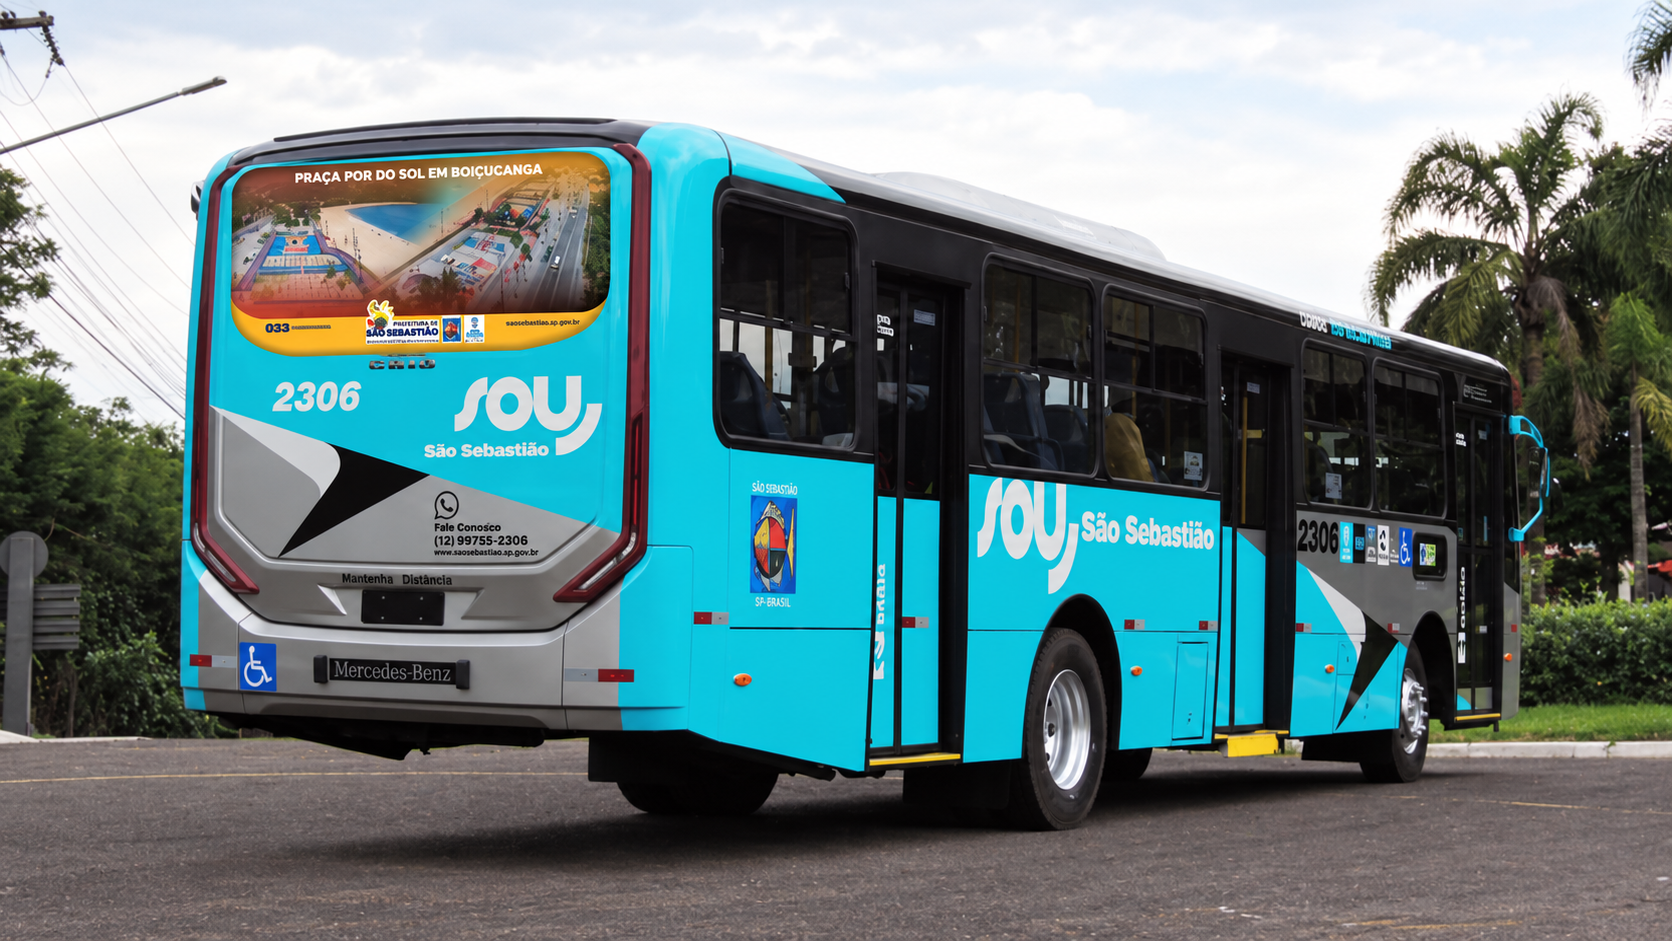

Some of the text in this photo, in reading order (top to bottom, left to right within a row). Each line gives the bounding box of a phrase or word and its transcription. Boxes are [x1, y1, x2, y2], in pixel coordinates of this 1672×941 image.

[295, 163, 543, 185] PRAÇA POR DO SOL EM BOIÇUCANGA
[265, 323, 290, 333] 033
[387, 325, 439, 337] SEBASTIÃO
[272, 381, 362, 412] 2306
[424, 442, 549, 459] São Sebastião
[752, 480, 798, 495] SÃO SEBASTIÃO
[434, 523, 502, 532] Fale Conosco
[1081, 511, 1215, 550] São Sebastião
[434, 535, 529, 547] (12) 99755-2306
[1297, 518, 1339, 554] 2306
[434, 549, 539, 558] www.saosebastiao.sp.gov.br
[342, 572, 453, 586] Mantenha Distância
[333, 659, 452, 683] Mercedes-Benz
